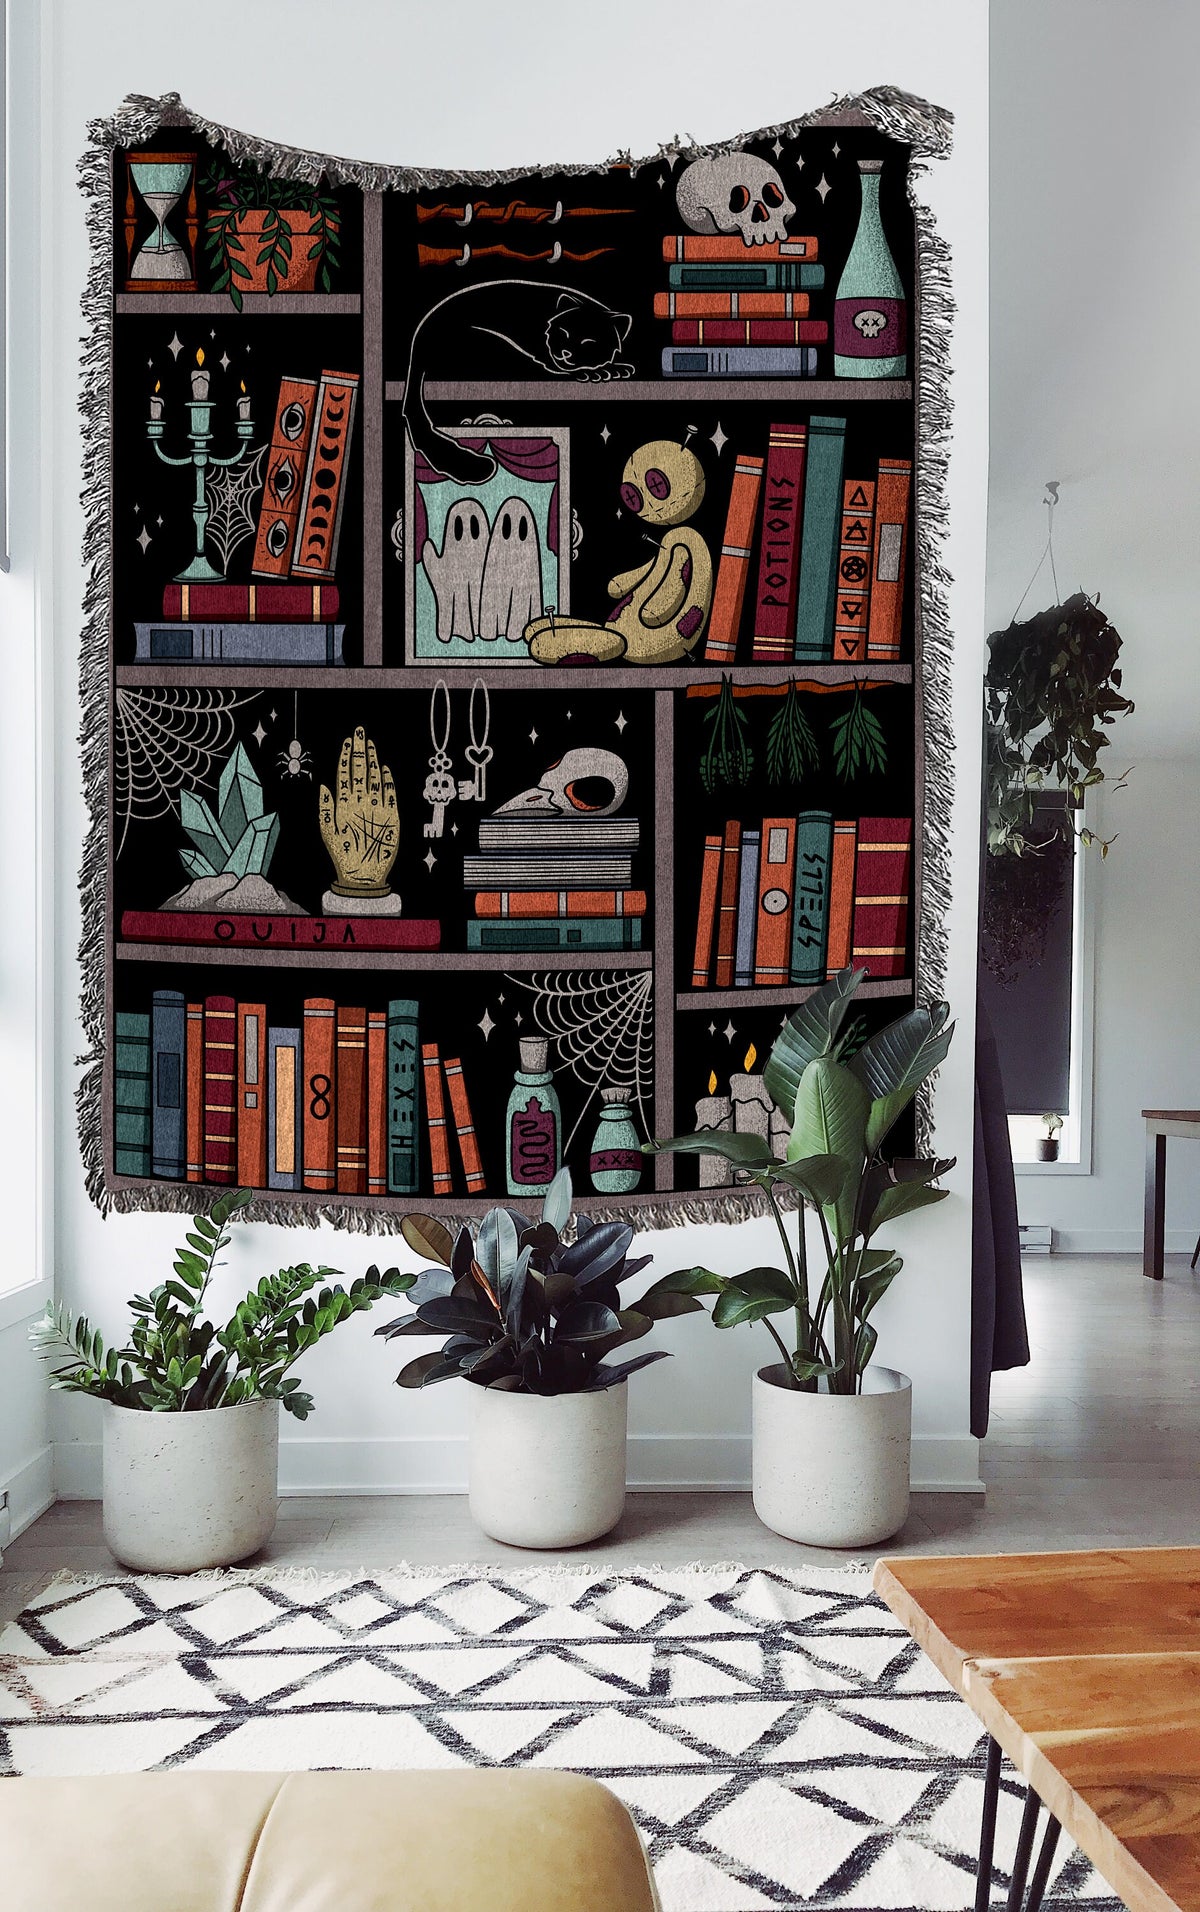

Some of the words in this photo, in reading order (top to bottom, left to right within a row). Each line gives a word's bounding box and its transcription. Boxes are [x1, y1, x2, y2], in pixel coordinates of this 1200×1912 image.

[761, 476, 795, 607] POTIONS
[213, 919, 357, 943] OUIJA
[797, 852, 826, 949] SPELLS
[390, 1038, 416, 1149] HEXES
